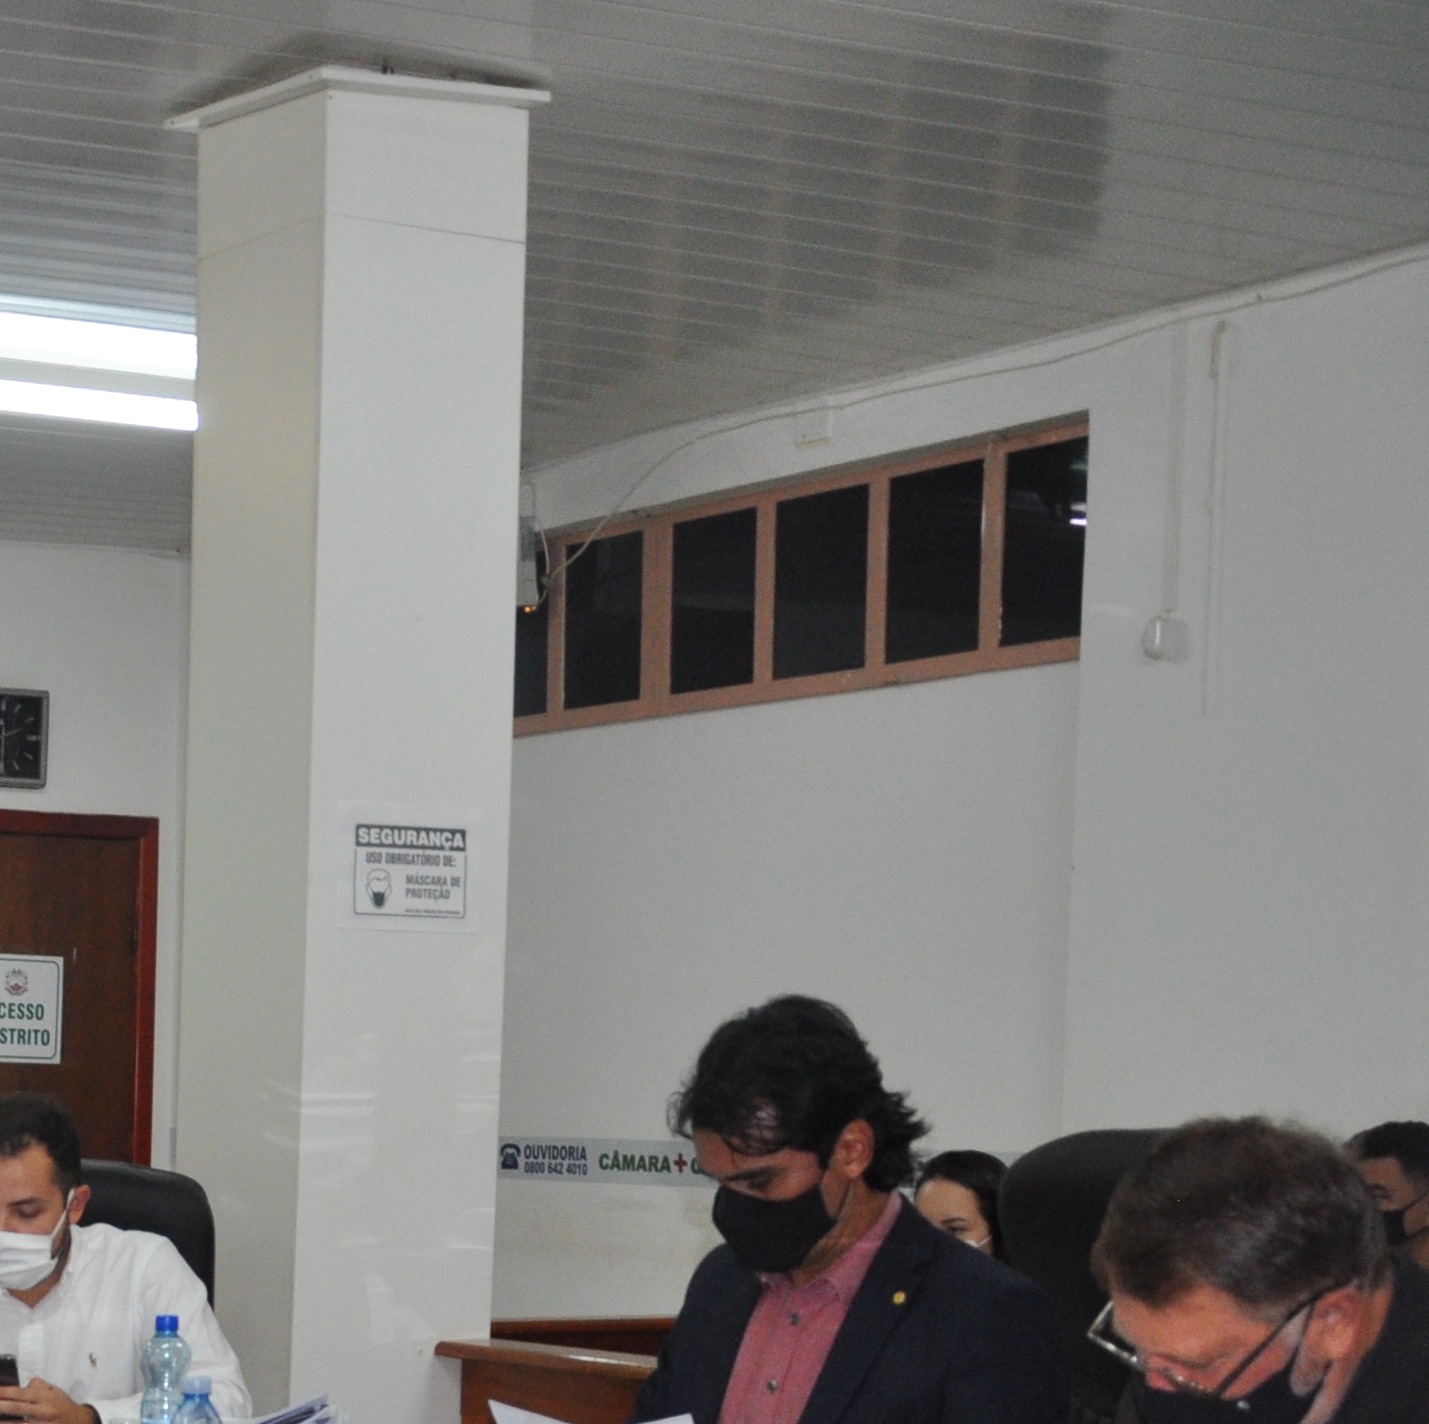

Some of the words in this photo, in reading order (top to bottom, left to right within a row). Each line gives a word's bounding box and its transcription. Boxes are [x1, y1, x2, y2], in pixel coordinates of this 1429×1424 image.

[357, 827, 464, 850] SEGURANÇA
[366, 851, 382, 864] USO
[385, 850, 440, 866] OBRIGATÓRIO
[443, 855, 456, 867] DE:
[405, 872, 448, 886] MÁSCARA
[450, 876, 461, 887] DE
[405, 887, 451, 900] PROTEÇÃO
[524, 1144, 587, 1162] OUVIDORIA
[566, 1163, 588, 1176] 4010
